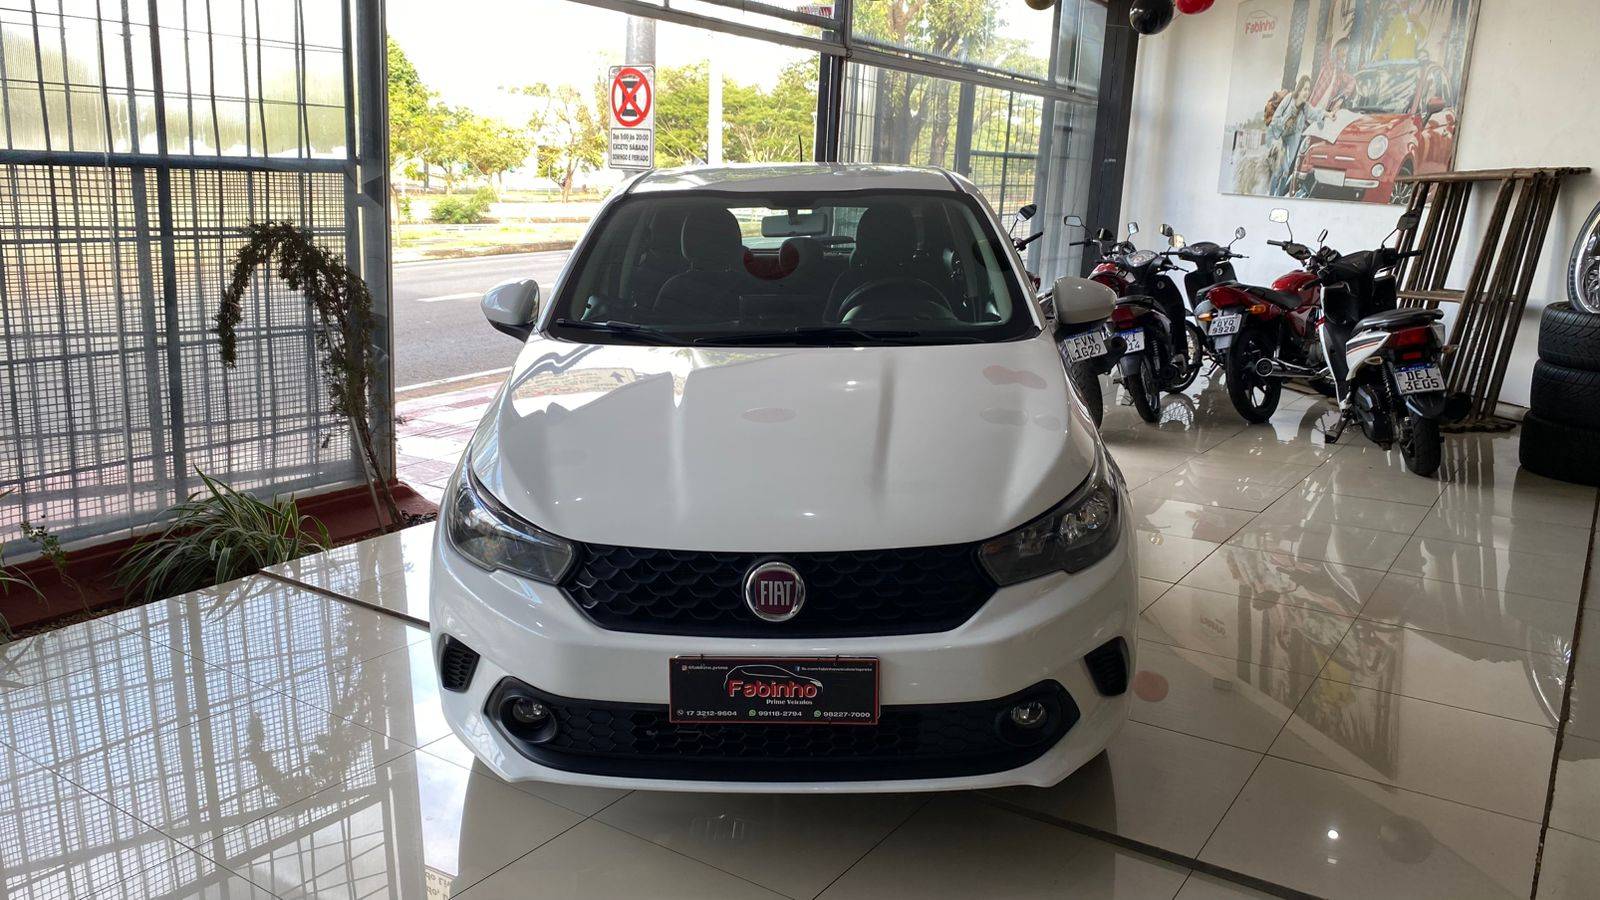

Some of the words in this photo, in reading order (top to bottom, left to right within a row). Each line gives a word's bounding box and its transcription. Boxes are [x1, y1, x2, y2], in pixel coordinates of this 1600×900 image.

[1074, 334, 1096, 346] FVN
[1074, 343, 1101, 359] 1G29
[760, 580, 793, 606] FIAT
[728, 680, 818, 698] Fabinho
